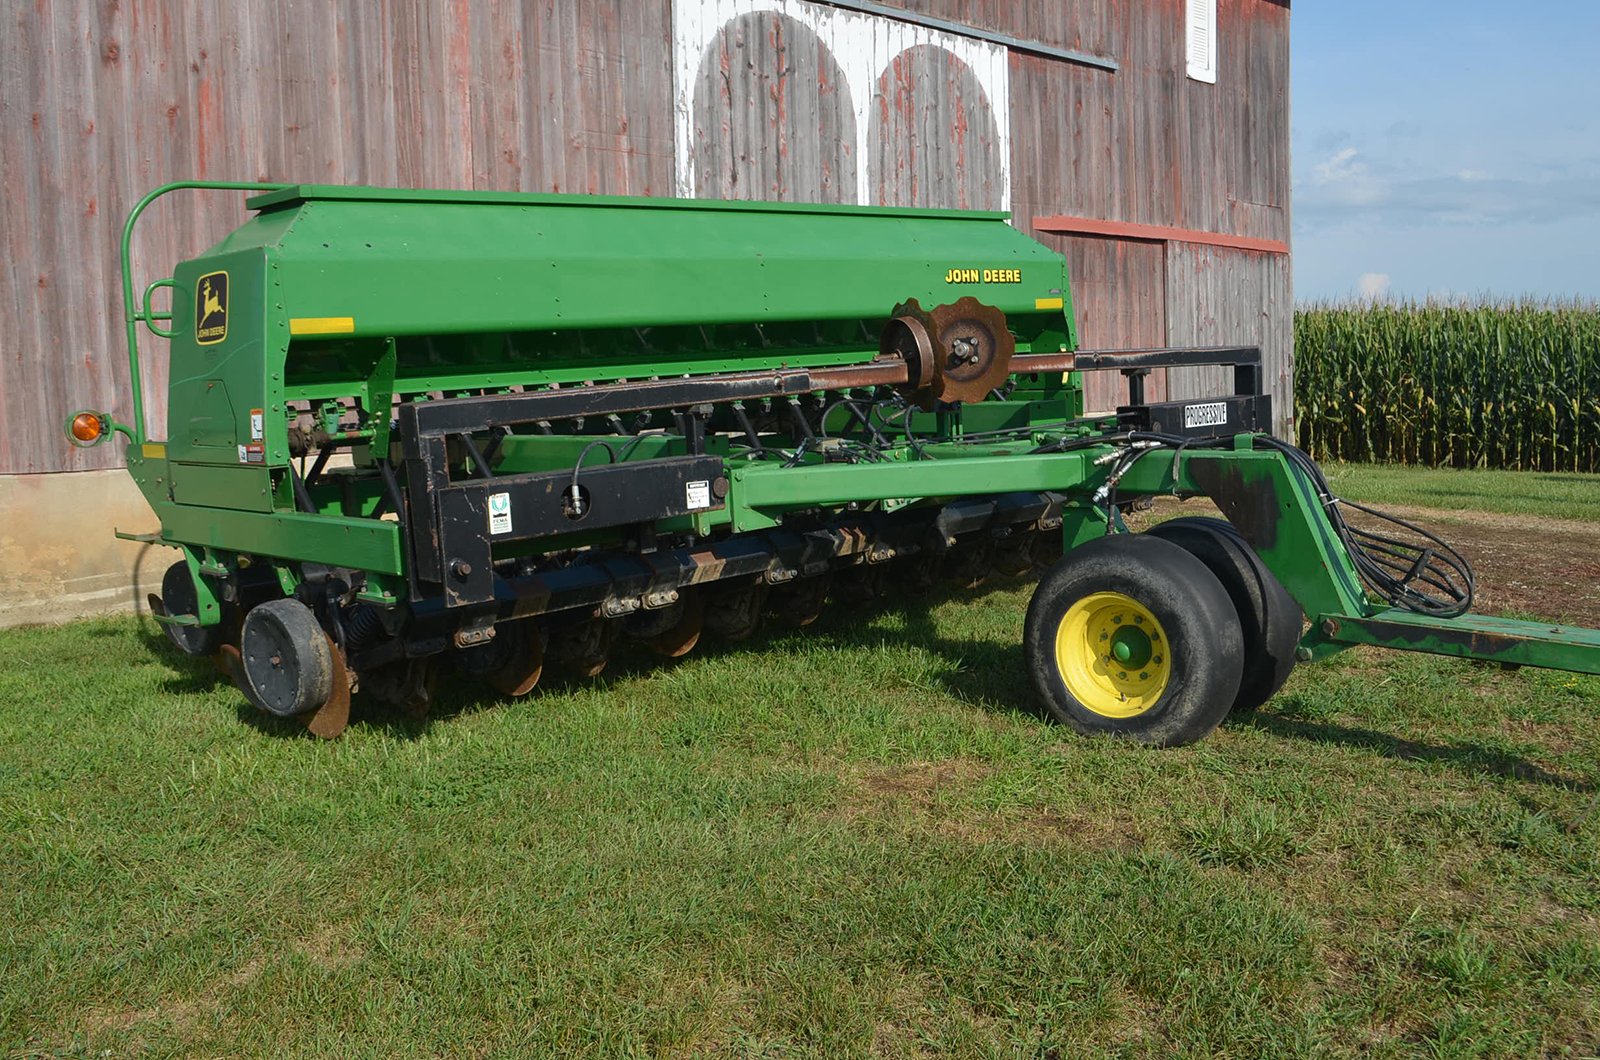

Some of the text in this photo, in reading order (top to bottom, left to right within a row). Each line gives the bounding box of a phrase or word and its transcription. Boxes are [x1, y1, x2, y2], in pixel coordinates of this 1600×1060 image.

[945, 269, 1021, 283] JOHN DEERE
[1186, 404, 1226, 426] PROGRESSIVE
